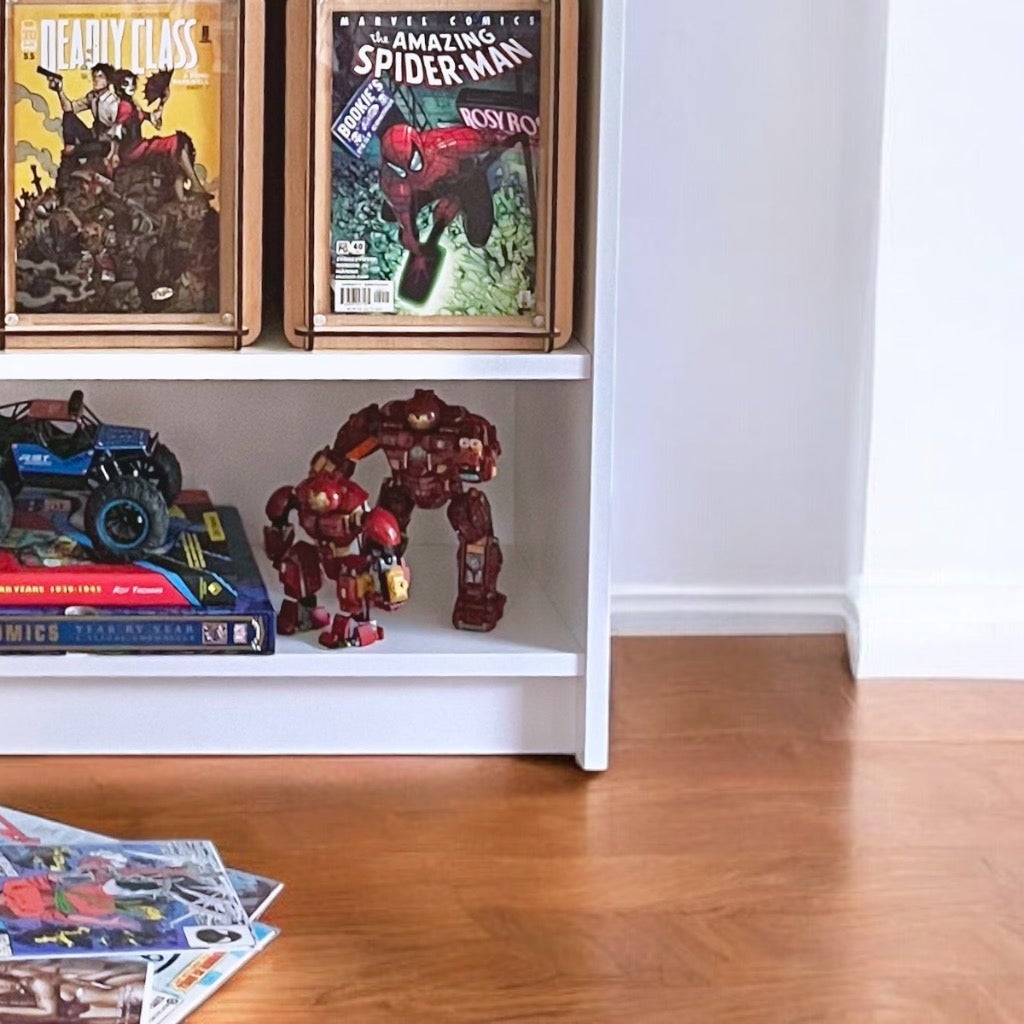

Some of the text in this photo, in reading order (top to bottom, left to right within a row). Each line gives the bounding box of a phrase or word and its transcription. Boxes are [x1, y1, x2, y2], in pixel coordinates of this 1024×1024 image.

[339, 15, 536, 27] MARVEL COMICS
[40, 18, 199, 75] DEADLY CLASS
[392, 28, 497, 52] AMAZING
[459, 107, 506, 131] ROSY
[14, 585, 45, 594] YEARS
[75, 624, 116, 634] YEAR
